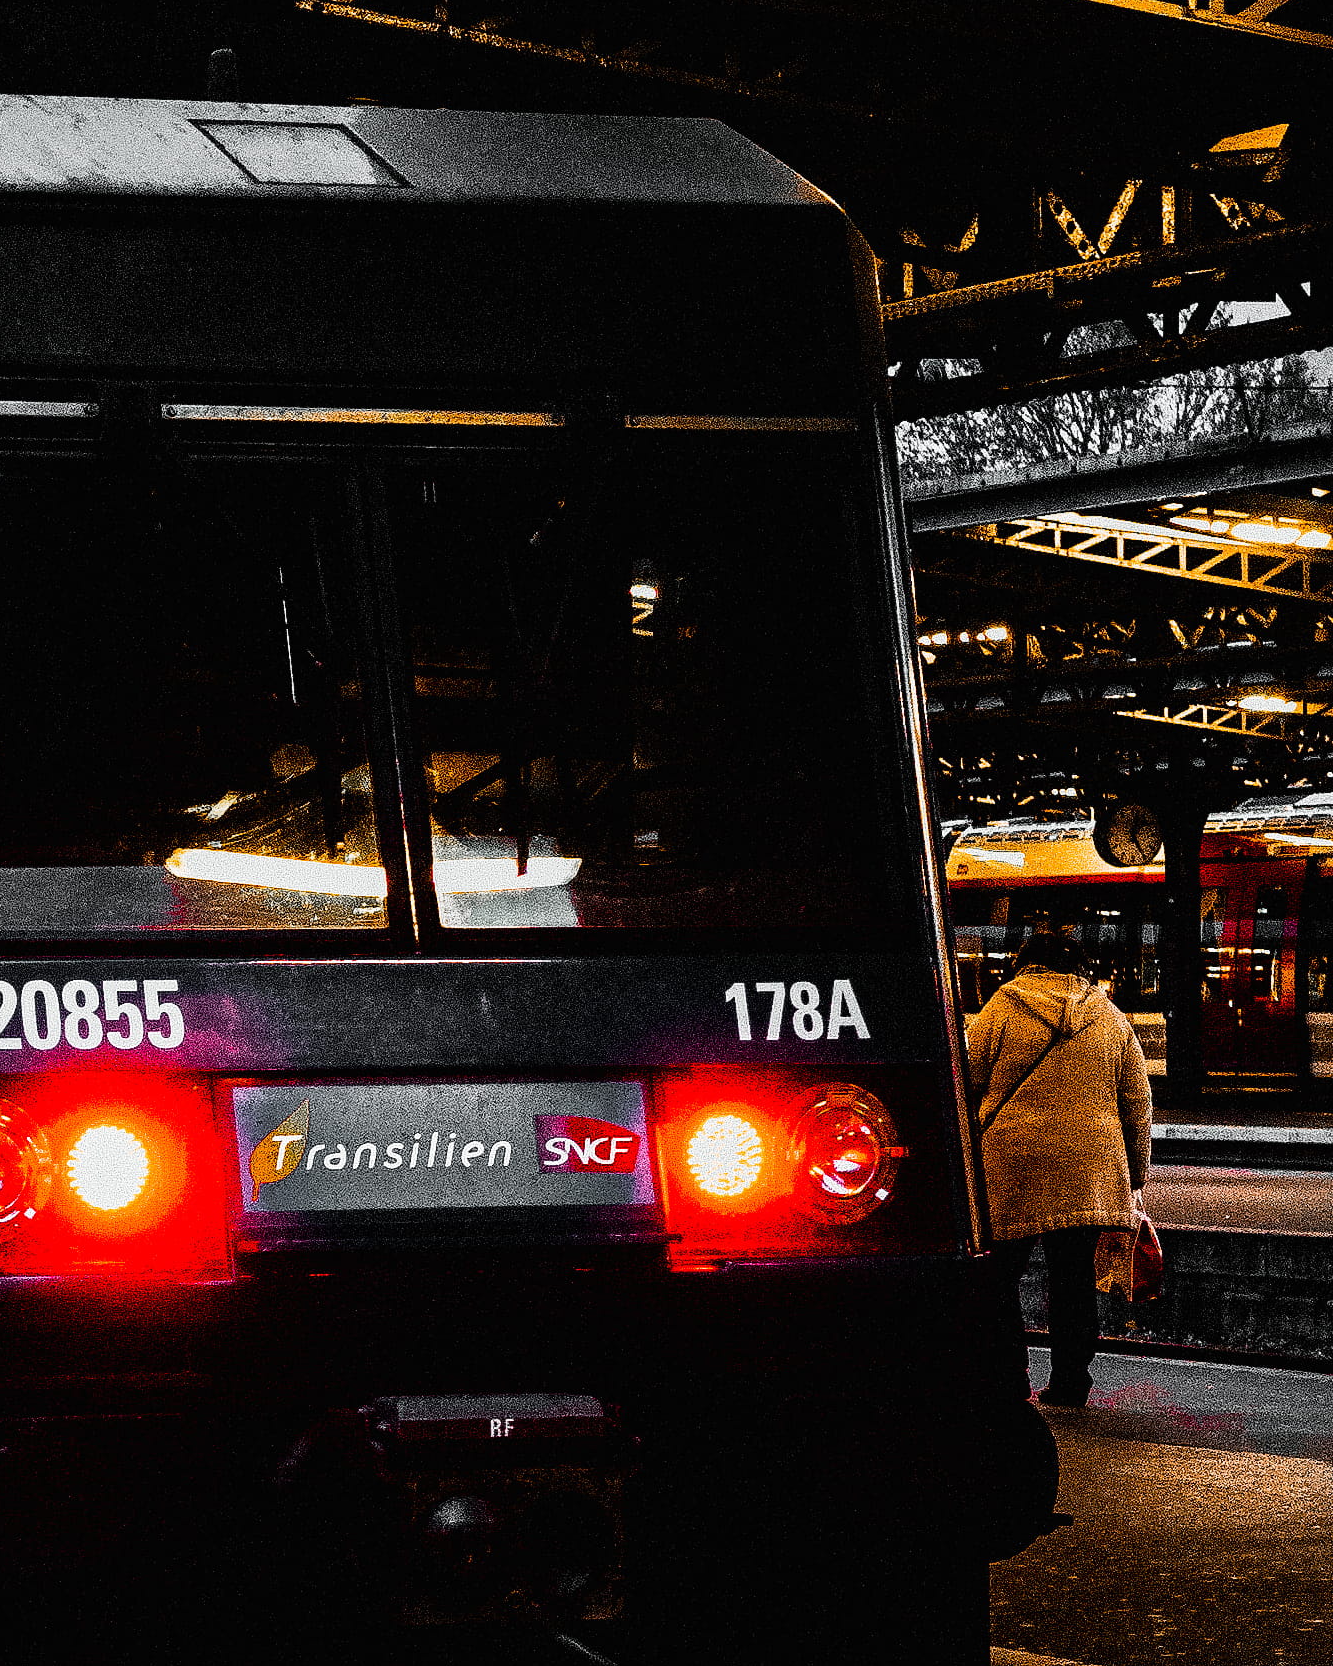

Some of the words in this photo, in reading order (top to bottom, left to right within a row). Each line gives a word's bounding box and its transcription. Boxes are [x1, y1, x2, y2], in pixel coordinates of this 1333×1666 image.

[725, 979, 871, 1041] 178A
[271, 1132, 512, 1171] Transilien
[543, 1136, 633, 1166] SNCF
[490, 1418, 515, 1438] RF
